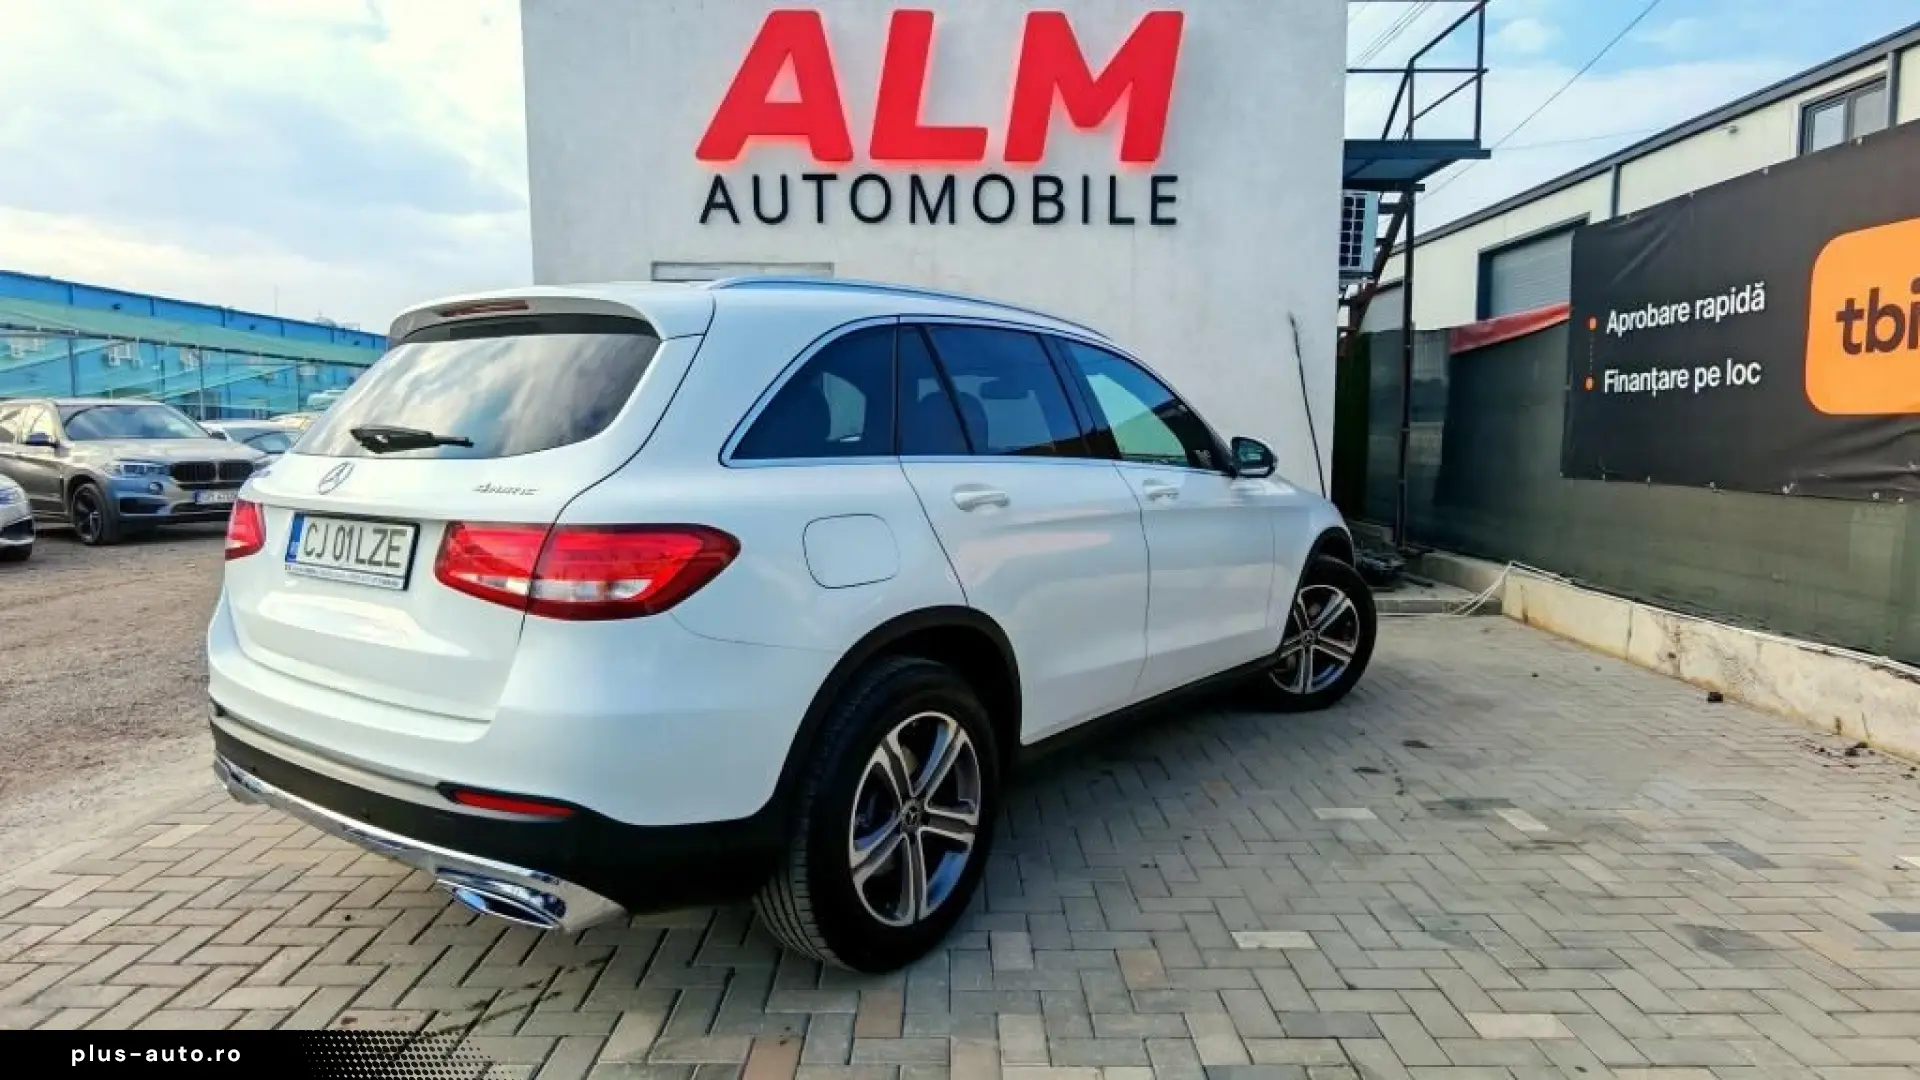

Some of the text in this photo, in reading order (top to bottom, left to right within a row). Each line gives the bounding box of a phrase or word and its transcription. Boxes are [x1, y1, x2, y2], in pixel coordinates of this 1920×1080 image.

[695, 9, 1185, 162] ALM
[699, 174, 1179, 225] AUTOMOBILE
[1606, 281, 1765, 338] Aprobare rapidă
[1836, 277, 1920, 354] tbi
[1604, 358, 1762, 397] Finanțare pe loc
[303, 522, 330, 557] CJ
